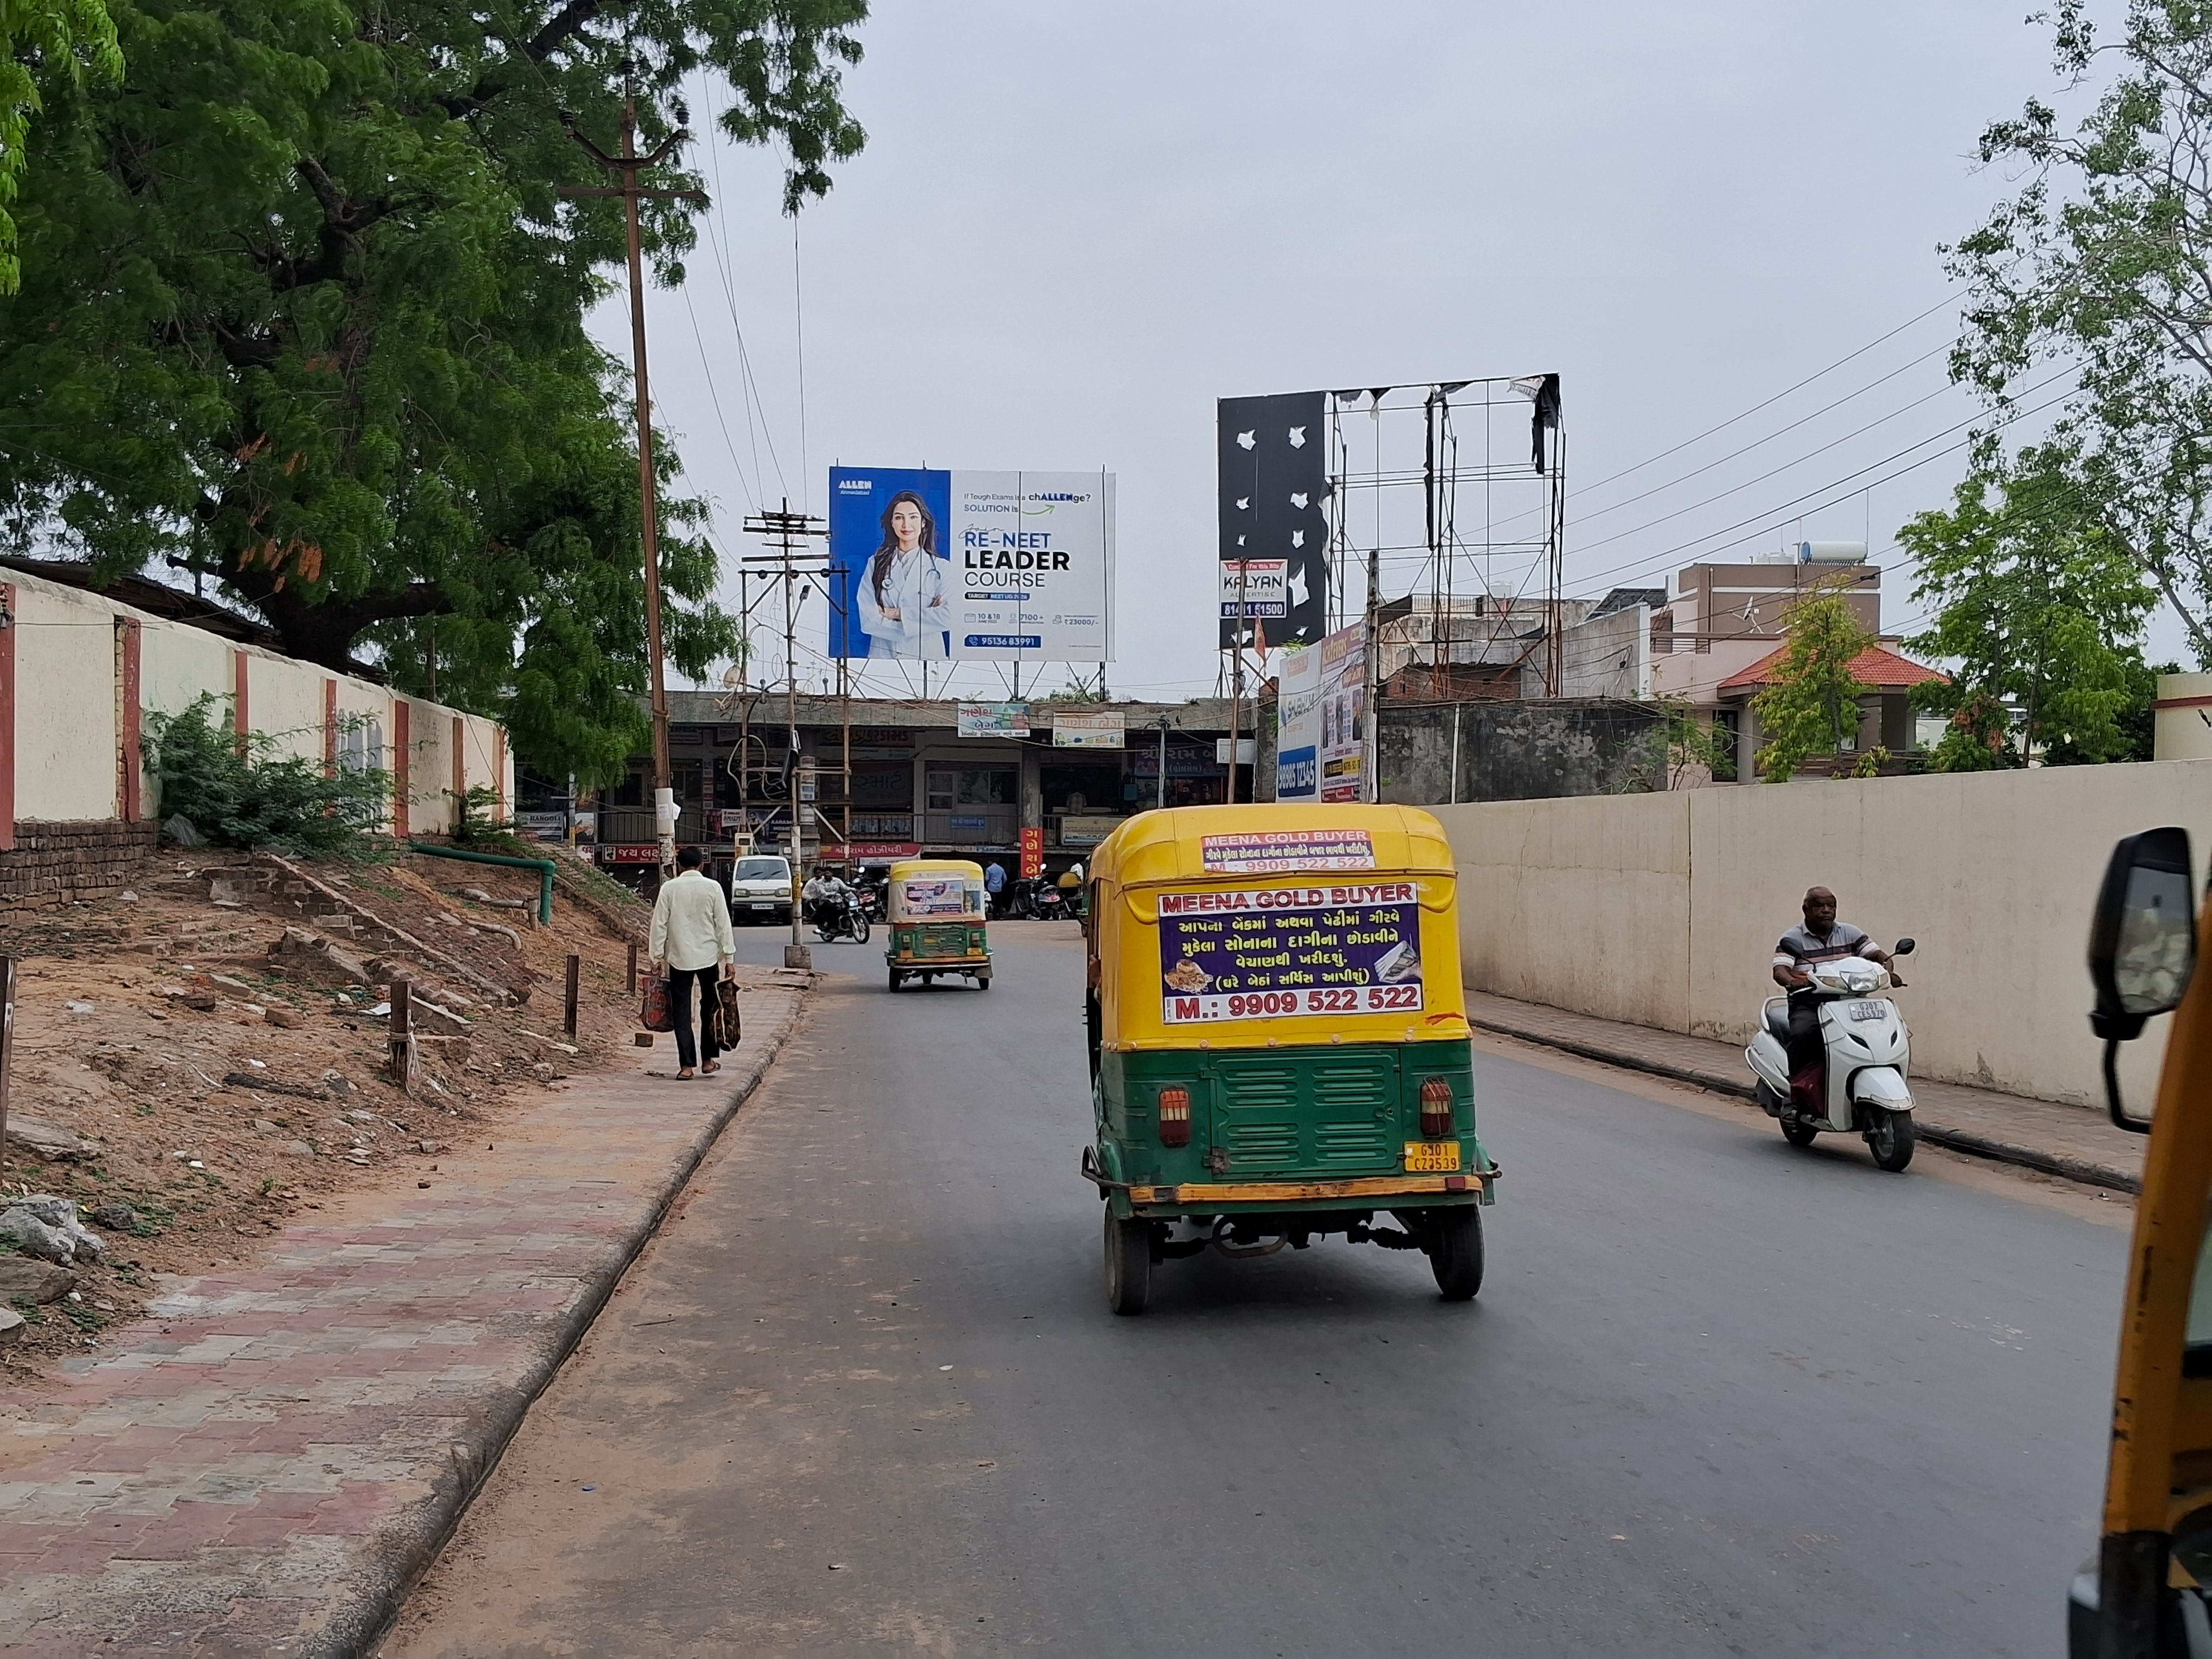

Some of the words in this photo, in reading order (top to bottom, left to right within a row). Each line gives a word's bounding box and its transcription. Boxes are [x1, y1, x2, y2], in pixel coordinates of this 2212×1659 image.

[838, 480, 872, 490] ALLEN
[1028, 493, 1091, 504] chALLENge?
[964, 504, 1009, 512] SOLUTION
[964, 532, 1052, 548] RE-NEET
[965, 550, 1070, 571] LEADER
[964, 571, 1045, 587] COURSE
[1224, 575, 1283, 590] KALYAN
[1167, 749, 1198, 759] રામ
[1205, 835, 1262, 846] MEENA
[1265, 832, 1309, 844] GOLD
[1314, 831, 1368, 841] BUYER
[618, 848, 638, 857] જય
[1245, 859, 1290, 871] 9909
[1297, 858, 1329, 869] 522
[1337, 857, 1369, 868] 522
[1162, 893, 1251, 913] MEENA
[1256, 889, 1324, 909] GOLD
[1331, 884, 1413, 905] BUYER
[1179, 922, 1223, 933] આપના
[1232, 915, 1266, 930] બેંકમાં
[1275, 916, 1314, 929] અથવા
[1322, 909, 1360, 927] પેઢીમાં
[1368, 908, 1400, 924] ગીરવે
[1181, 937, 1216, 957] મુકેલા
[1224, 934, 1277, 950] સોનાના
[1288, 930, 1338, 948] દાગીના
[1347, 928, 1399, 944] છોડાવીને
[1236, 951, 1290, 968] વેચાણથી
[1216, 974, 1239, 992] (ઘરે
[1247, 972, 1270, 986] બેઠાં
[1278, 970, 1314, 985] સર્વિસ
[1321, 967, 1370, 985] આપીશું)
[1175, 998, 1218, 1020] M.:
[1228, 992, 1298, 1017] 9909
[1308, 989, 1358, 1011] 522
[1368, 986, 1418, 1009] 522
[1421, 1144, 1448, 1156] GJ01
